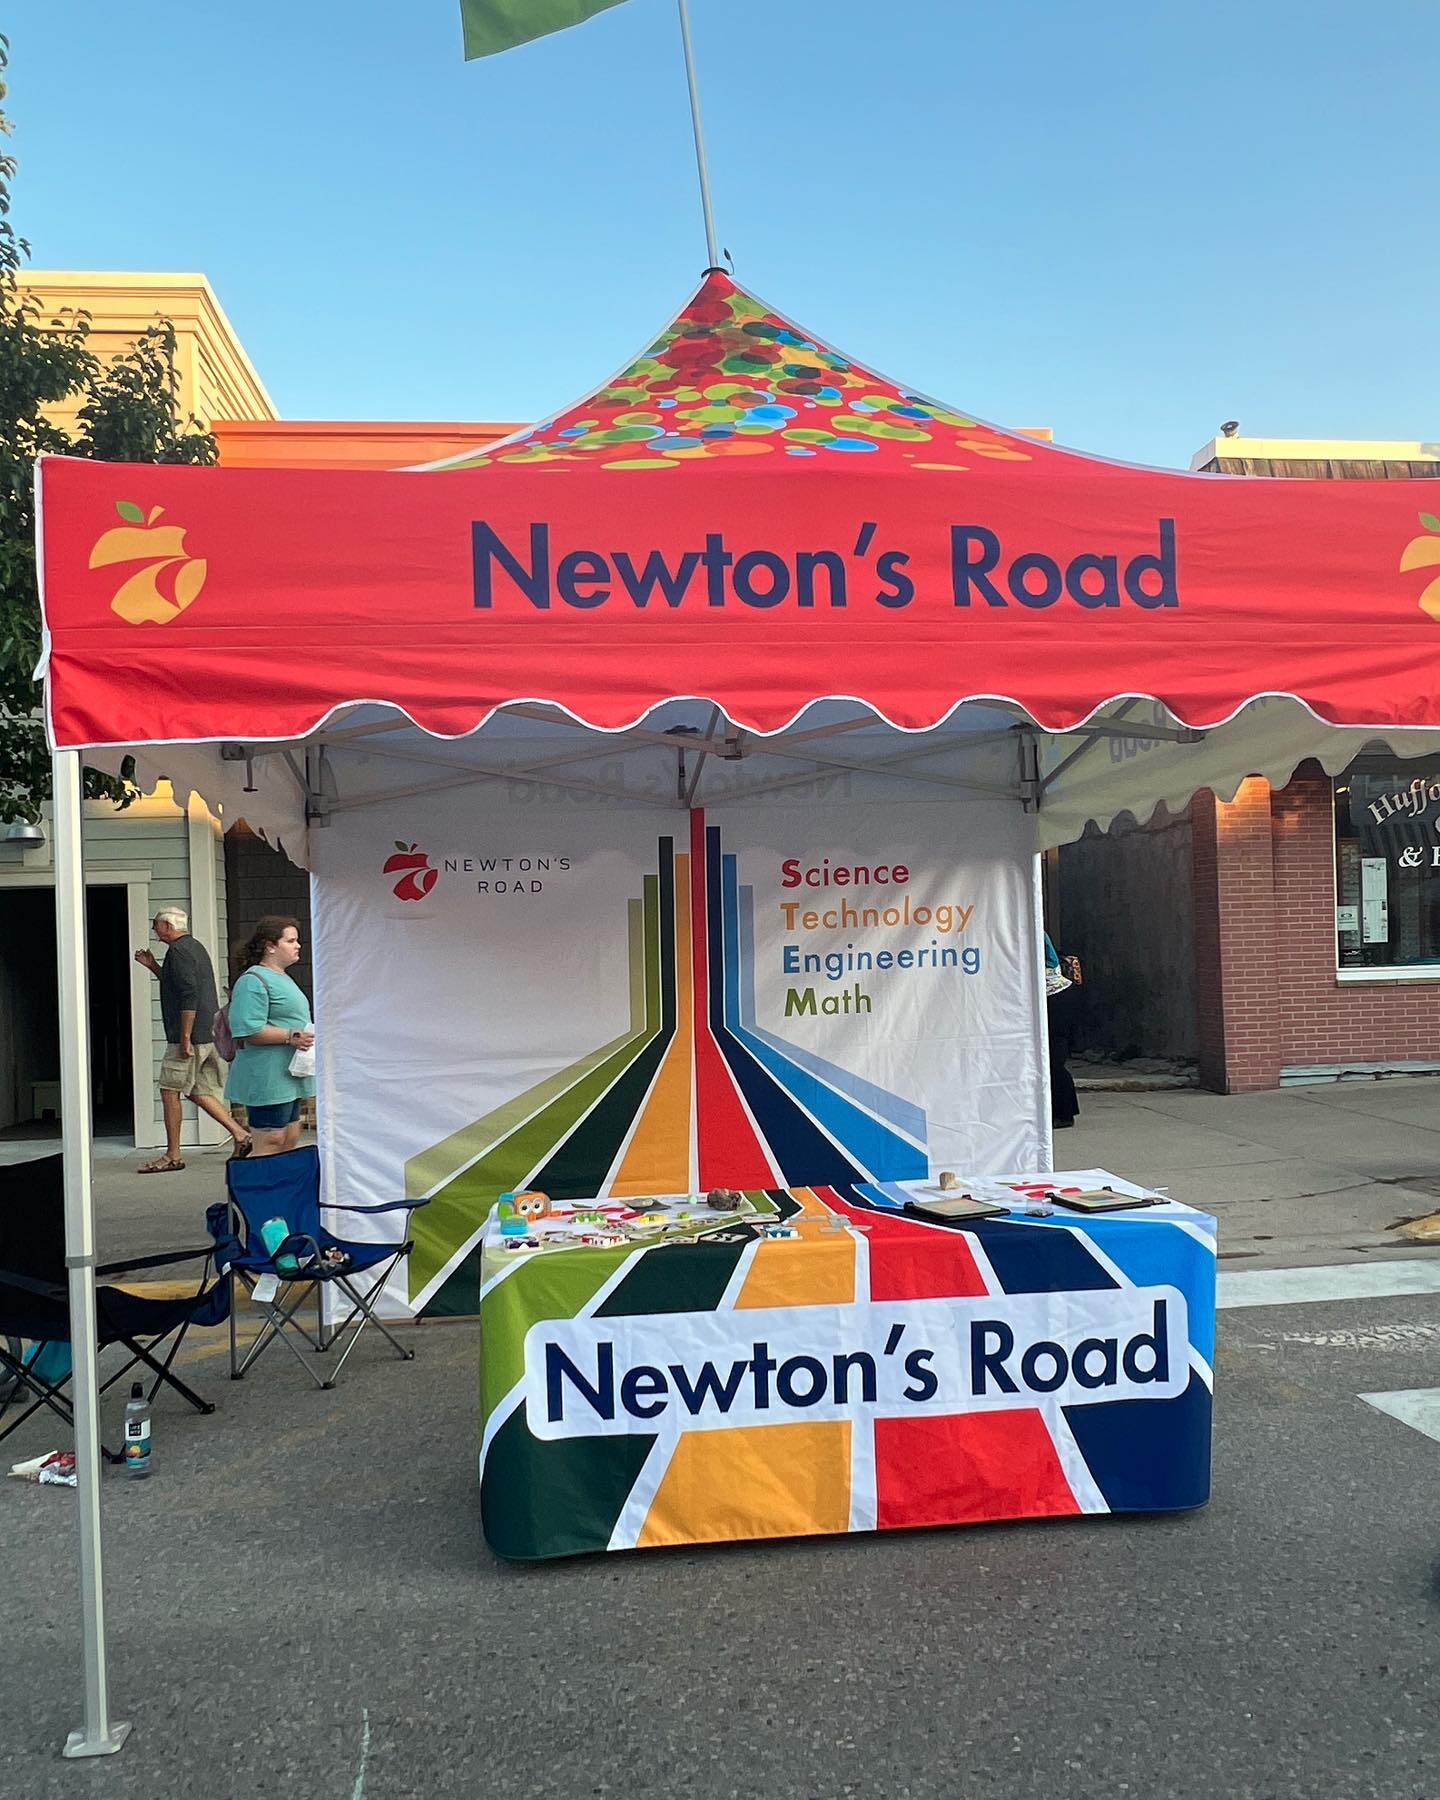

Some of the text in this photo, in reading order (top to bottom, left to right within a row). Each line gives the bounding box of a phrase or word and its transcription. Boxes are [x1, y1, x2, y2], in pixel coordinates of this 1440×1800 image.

[471, 518, 1179, 610] Newton's Road
[444, 858, 571, 872] NEWTON'S
[781, 858, 910, 888] Science
[1398, 846, 1424, 868] &
[477, 880, 543, 894] ROAD
[780, 895, 975, 934] Technology
[783, 939, 981, 981] Engineering
[784, 983, 872, 1017] Math
[545, 1299, 1170, 1423] Newton's Road
